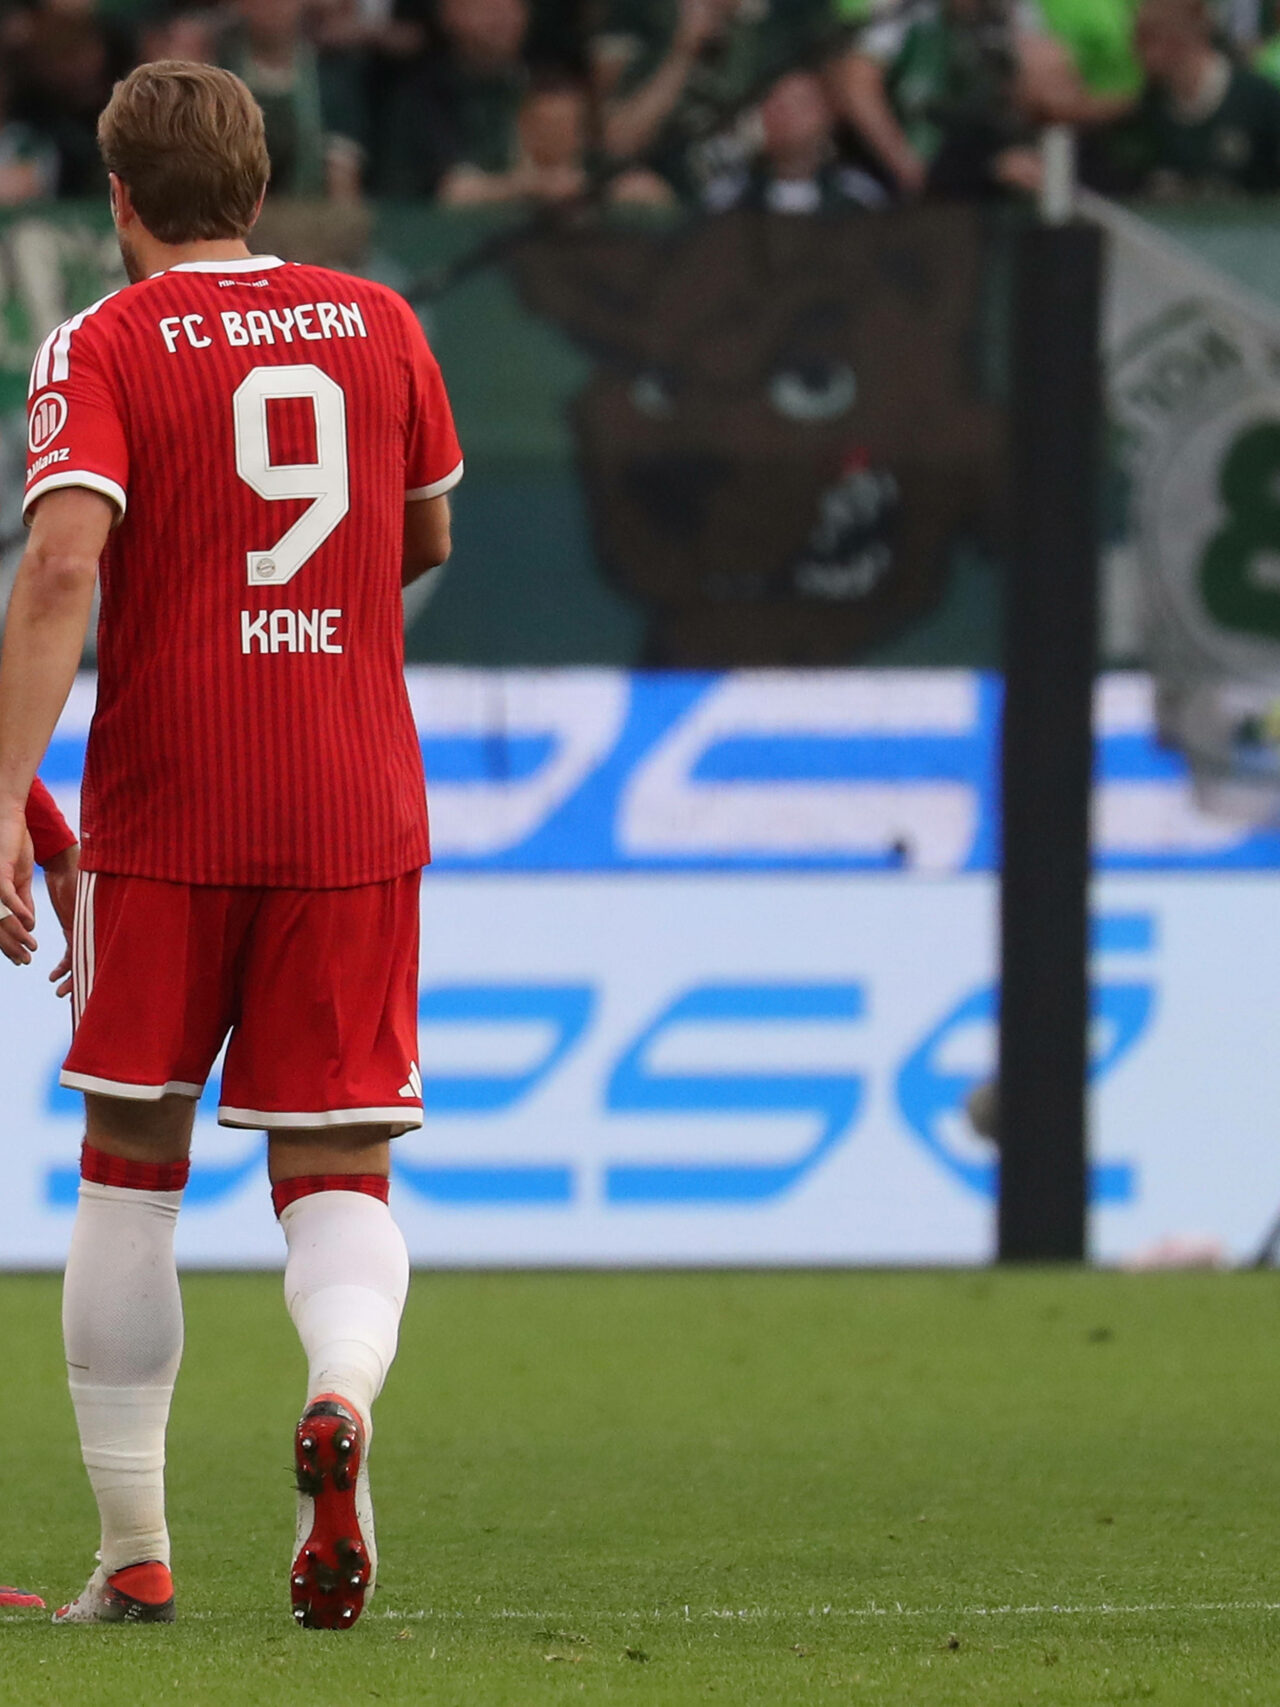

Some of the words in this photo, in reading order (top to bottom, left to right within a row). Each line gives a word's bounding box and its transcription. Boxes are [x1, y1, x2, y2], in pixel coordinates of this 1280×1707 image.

[159, 314, 212, 352] FC
[221, 302, 367, 347] BAYERN
[233, 364, 349, 585] 9
[241, 609, 342, 654] KANE
